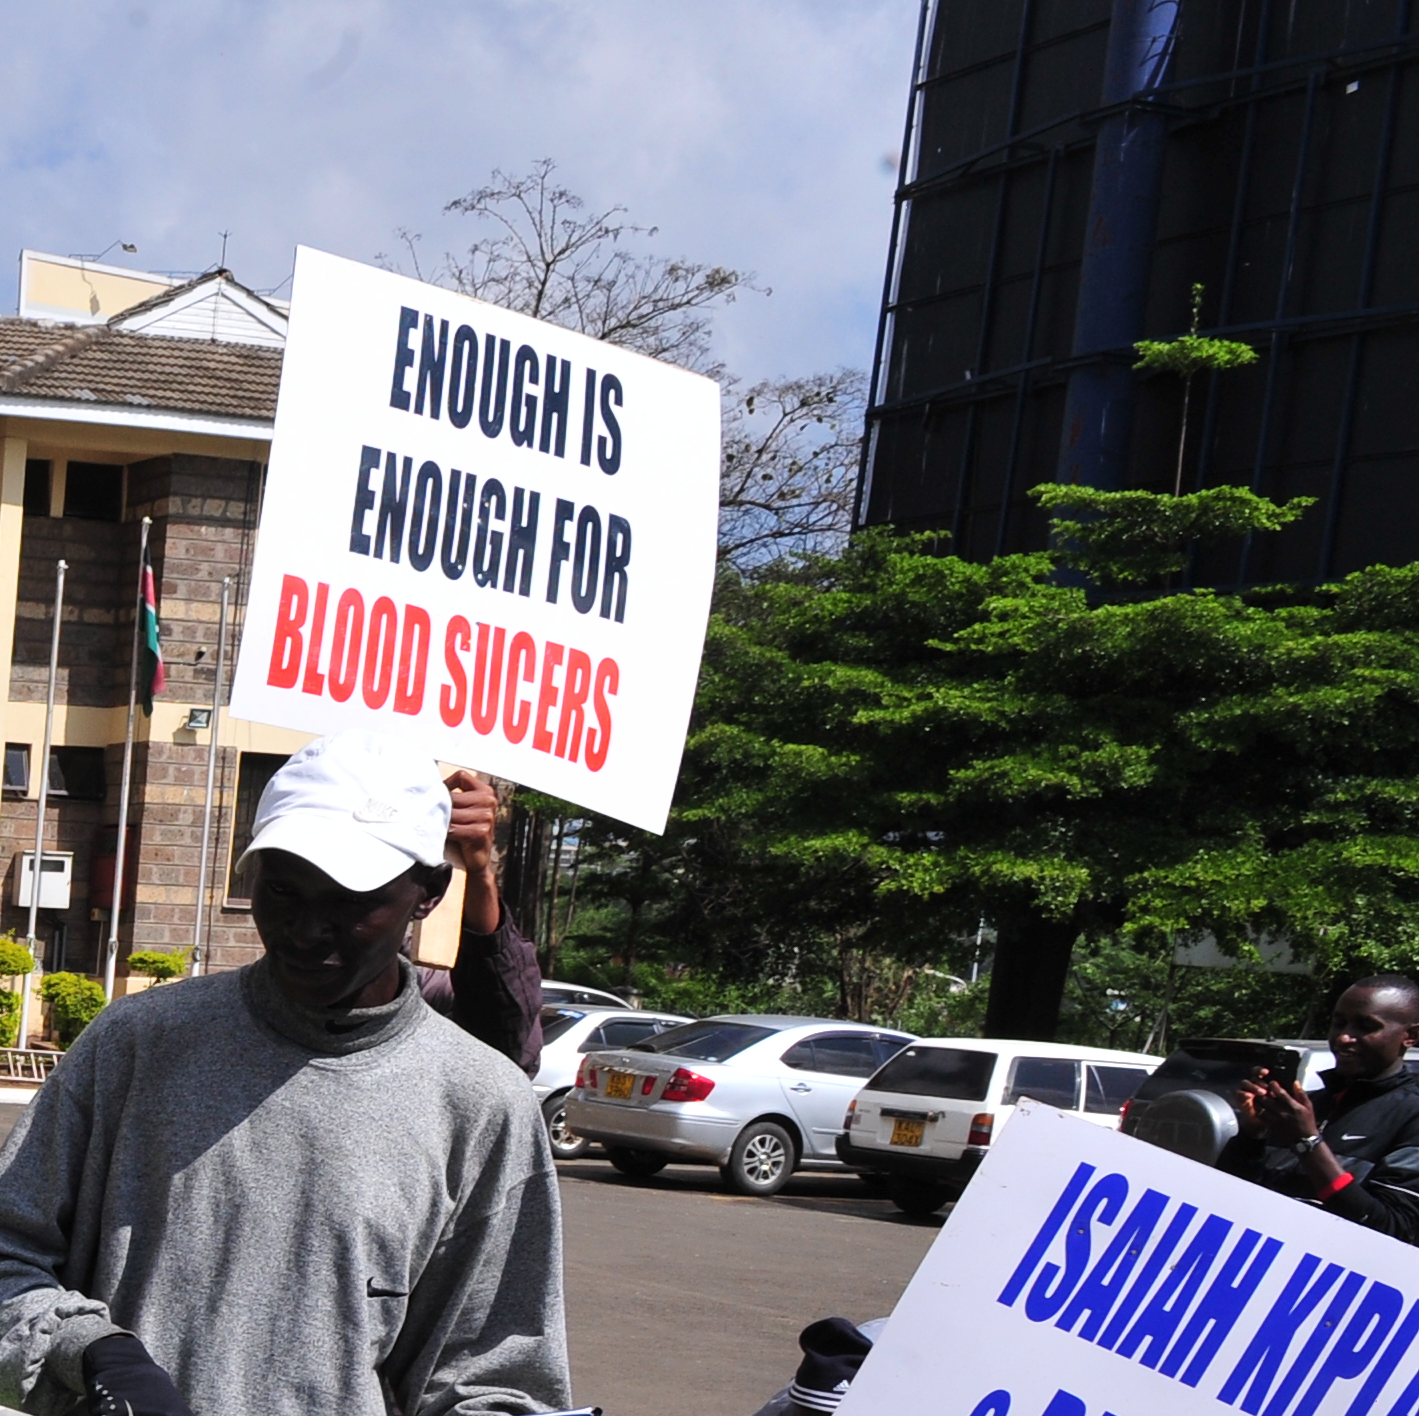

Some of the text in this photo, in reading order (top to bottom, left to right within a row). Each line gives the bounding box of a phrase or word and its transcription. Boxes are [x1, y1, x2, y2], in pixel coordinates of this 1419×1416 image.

[389, 306, 624, 476] ENOUGH IS
[349, 445, 631, 624] ENOUGH FOR
[266, 574, 620, 773] BLOOD SUCERS
[996, 1162, 1284, 1388] ISAIAH
